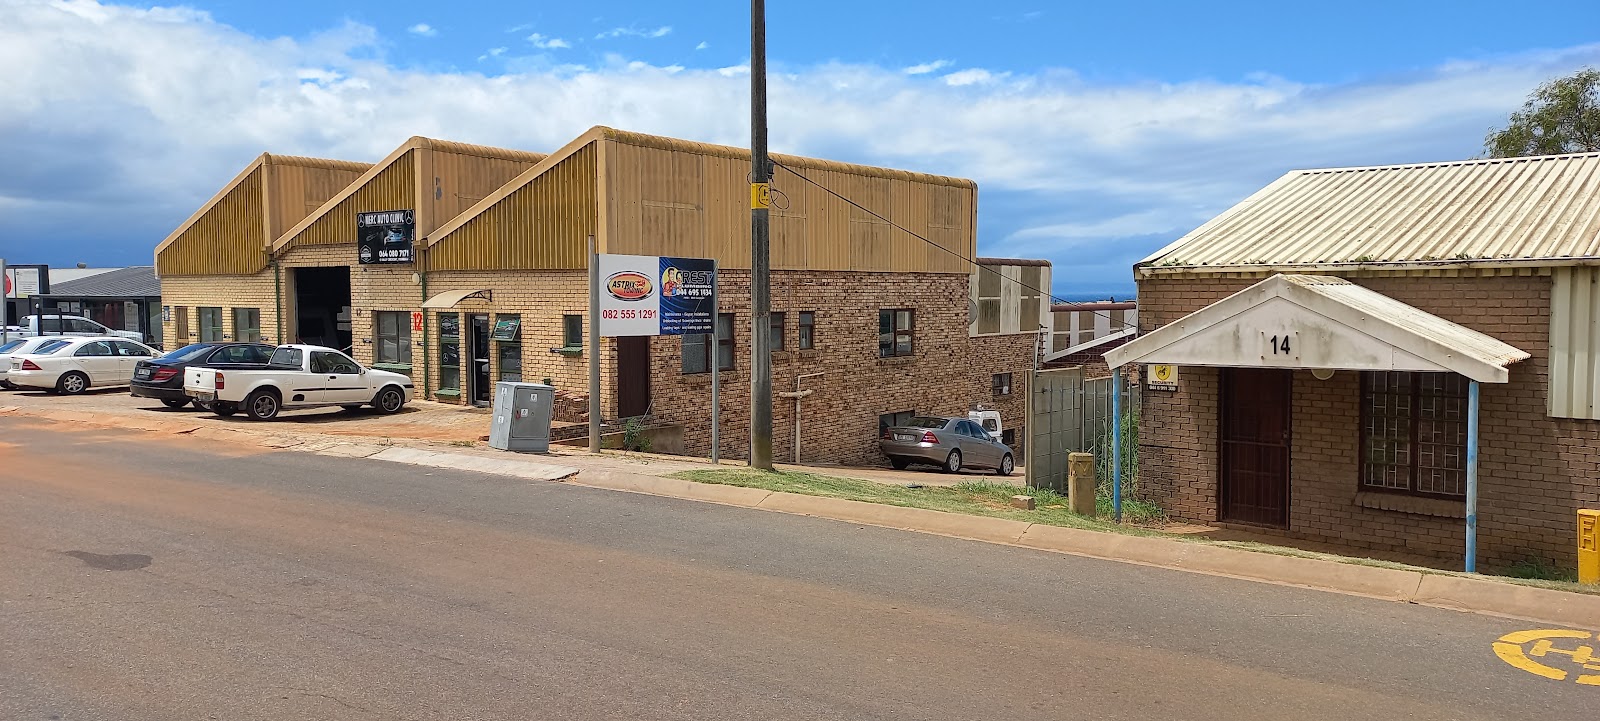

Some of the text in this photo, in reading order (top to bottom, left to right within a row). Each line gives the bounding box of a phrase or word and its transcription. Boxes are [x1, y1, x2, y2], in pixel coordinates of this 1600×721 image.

[378, 214, 389, 224] AUTO
[390, 213, 404, 223] CLINIC
[378, 250, 388, 258] 064
[602, 309, 657, 319] 082 555 1291
[413, 312, 423, 331] 12
[1270, 334, 1291, 355] 14
